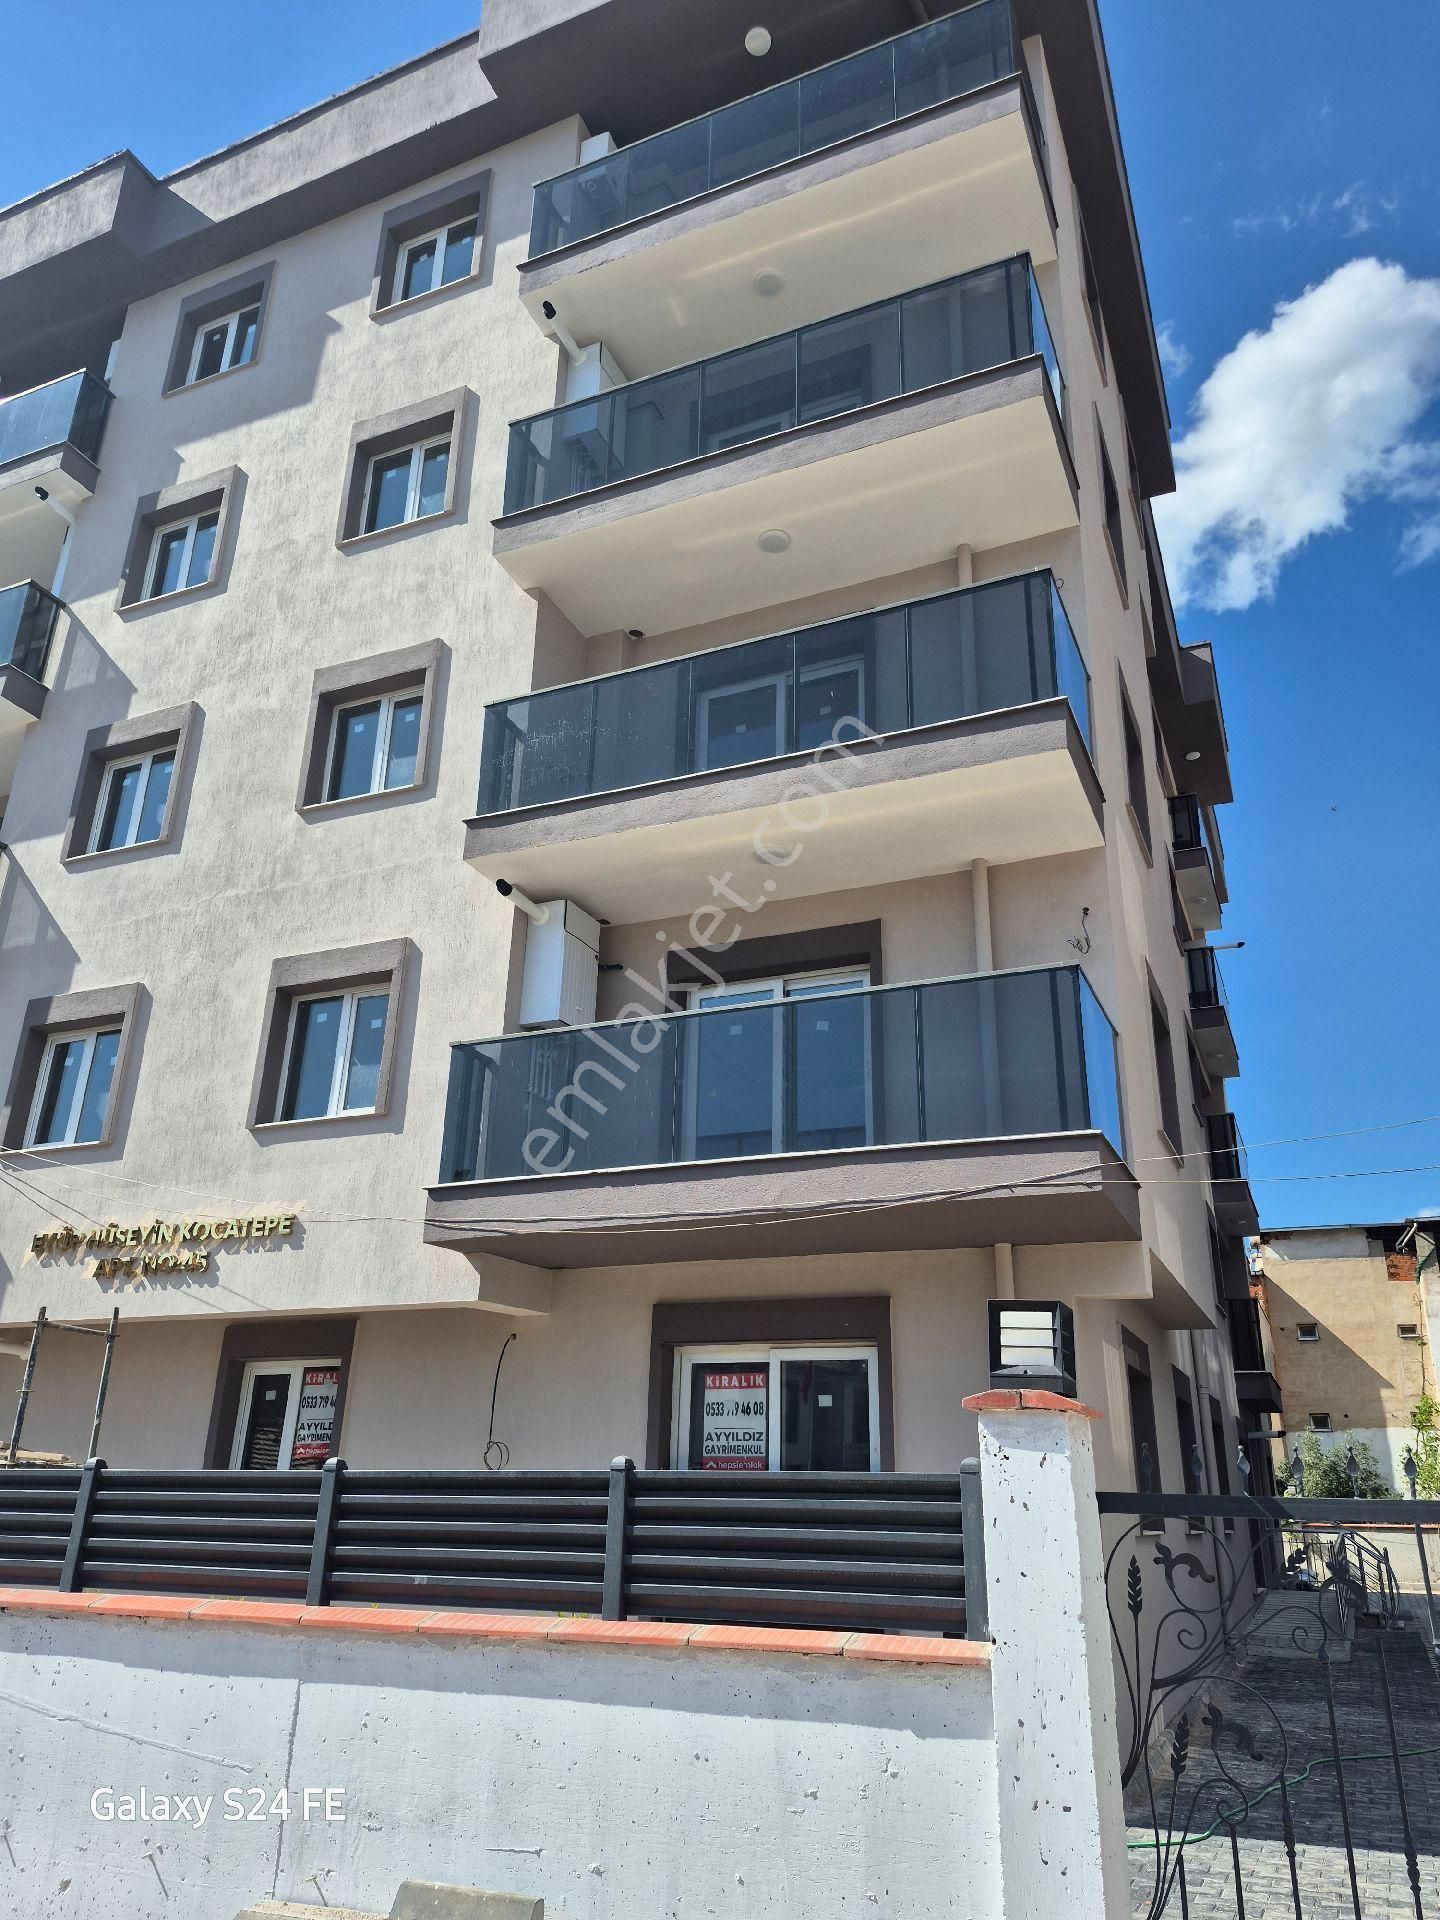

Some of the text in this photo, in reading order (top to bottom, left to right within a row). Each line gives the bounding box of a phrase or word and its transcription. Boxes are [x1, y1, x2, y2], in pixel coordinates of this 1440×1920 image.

[179, 1213, 296, 1242] KOCATEPE
[301, 1395, 317, 1409] 0533
[705, 1401, 725, 1416] 0533
[741, 1401, 752, 1416] 46
[753, 1400, 764, 1416] 08
[705, 1431, 764, 1442] AYYILDIZ
[704, 1441, 764, 1455] GAYRİMENKUL
